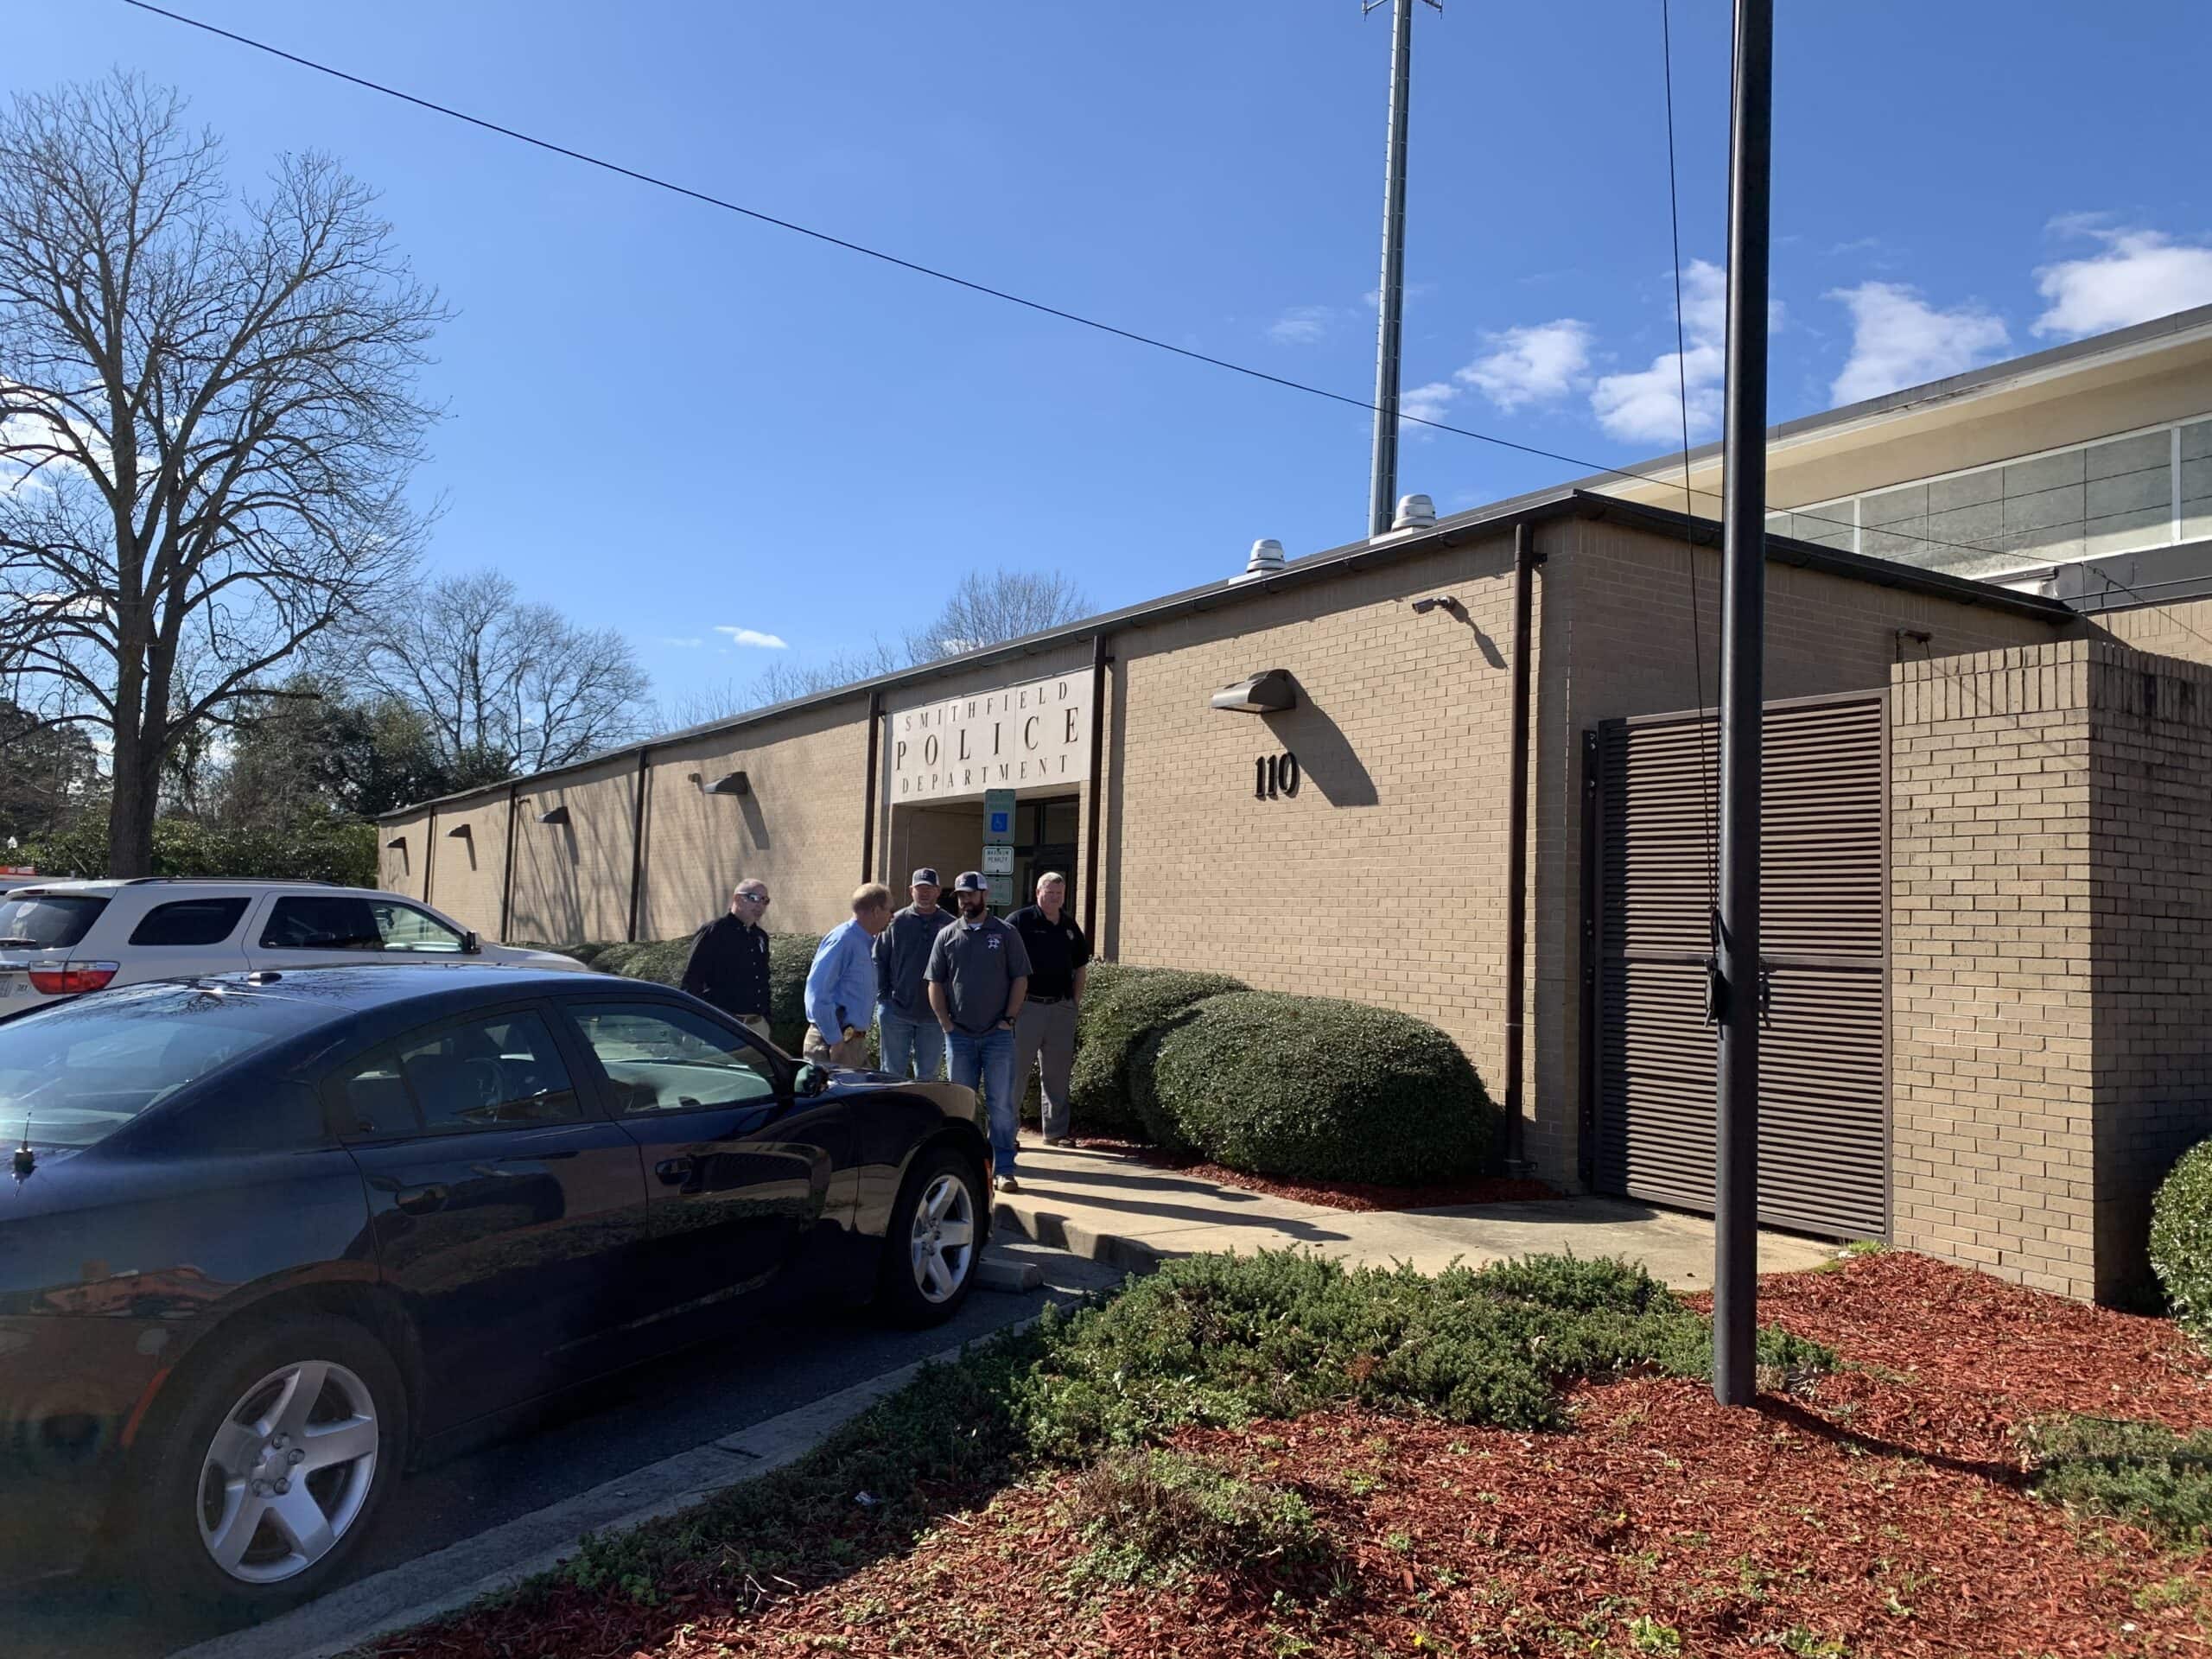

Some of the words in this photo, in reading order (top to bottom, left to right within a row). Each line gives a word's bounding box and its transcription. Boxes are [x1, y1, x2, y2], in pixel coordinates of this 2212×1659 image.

[906, 681, 1067, 732] SMITHFIELD
[896, 707, 1079, 771] POLICE
[902, 754, 1068, 793] DEPARTMENT
[1255, 752, 1299, 799] 110
